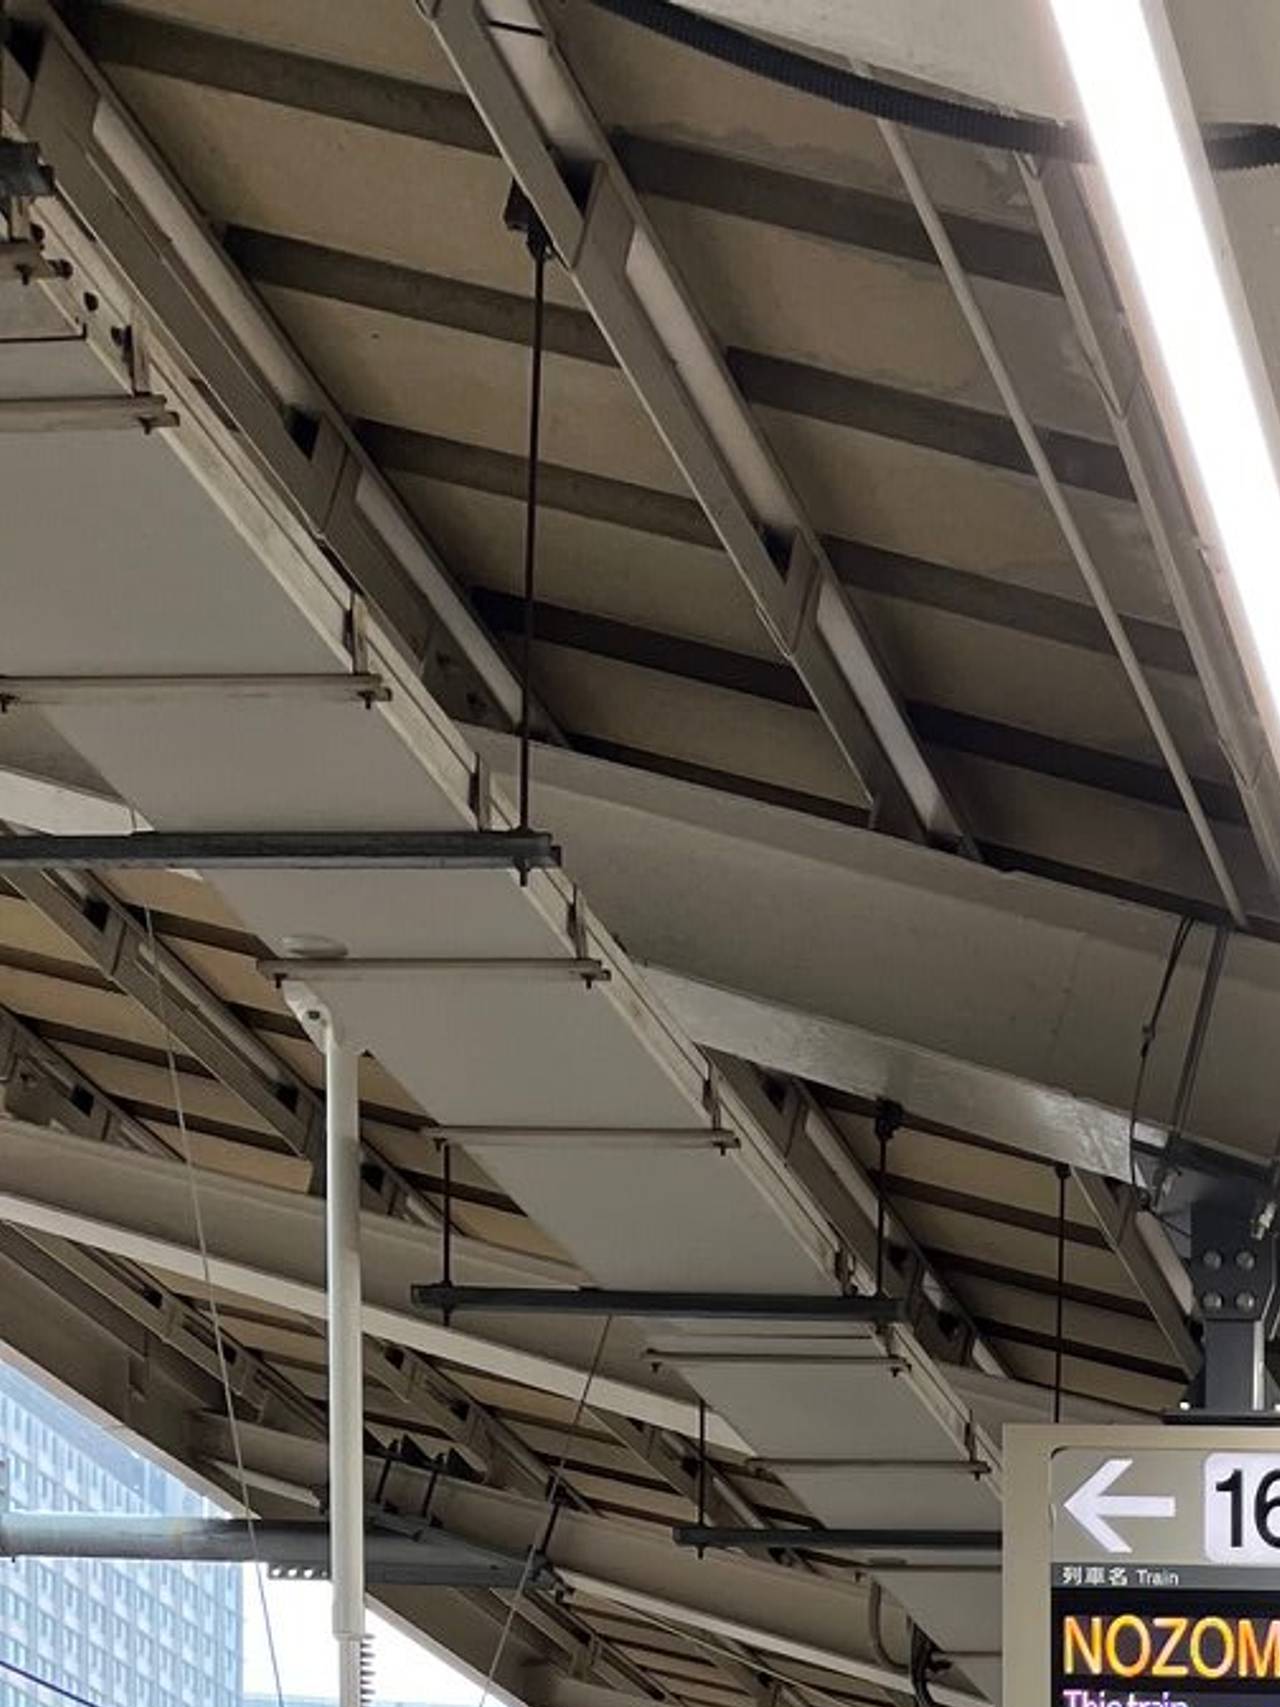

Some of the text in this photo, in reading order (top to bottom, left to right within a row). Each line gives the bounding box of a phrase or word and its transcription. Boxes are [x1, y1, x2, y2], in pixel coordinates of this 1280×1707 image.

[1062, 1565, 1180, 1587] 列車名 Train
